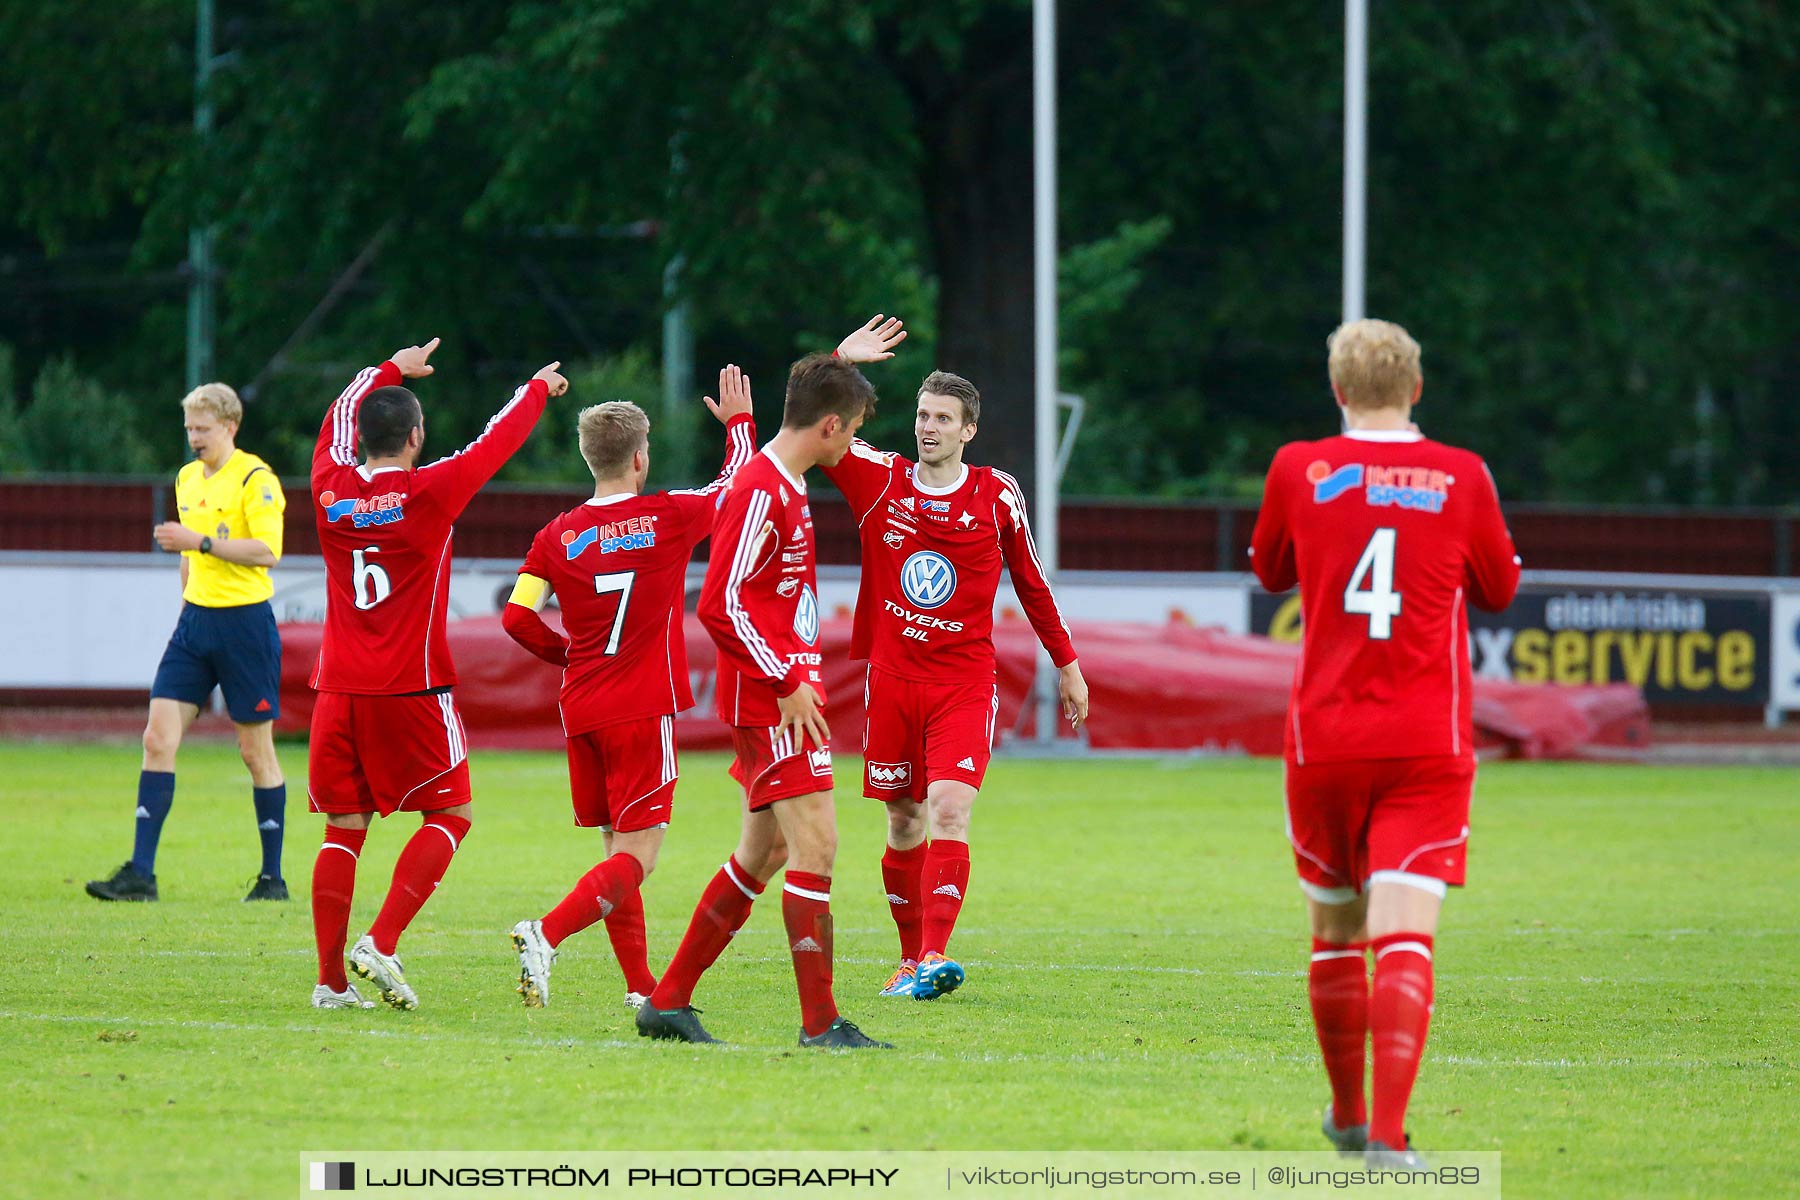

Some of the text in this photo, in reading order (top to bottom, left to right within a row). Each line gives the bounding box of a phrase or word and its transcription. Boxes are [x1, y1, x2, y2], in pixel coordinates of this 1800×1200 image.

[1365, 465, 1447, 493] INTER
[352, 492, 402, 514] INTER
[1365, 485, 1447, 514] SPORT
[352, 505, 404, 528] SPORT
[599, 516, 655, 540] INTER
[600, 532, 656, 554] SPORT
[352, 545, 392, 611] 6
[1343, 527, 1402, 640] 4
[594, 569, 636, 655] 7
[884, 599, 964, 632] TOVEKS
[1545, 591, 1705, 631] elektriska
[901, 626, 929, 642] BIL
